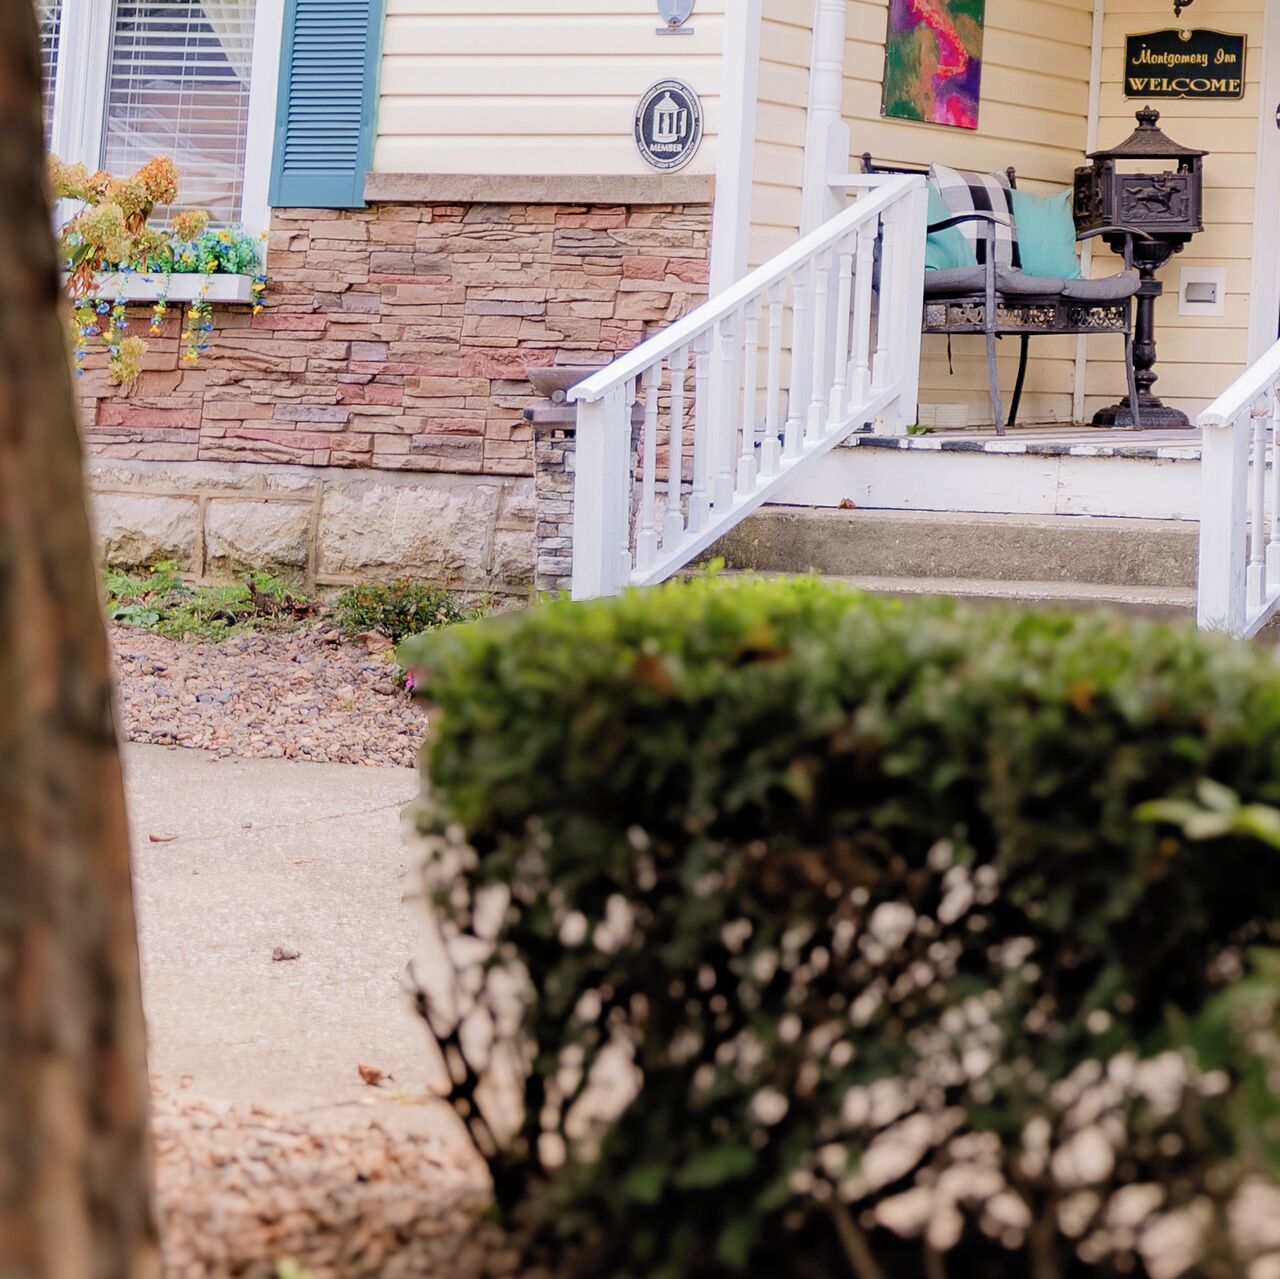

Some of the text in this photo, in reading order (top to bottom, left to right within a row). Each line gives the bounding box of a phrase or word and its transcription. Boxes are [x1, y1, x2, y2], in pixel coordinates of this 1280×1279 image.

[1132, 48, 1237, 67] Montgomery Inn
[1128, 77, 1240, 92] WELCOME
[649, 143, 683, 153] MEMBER
